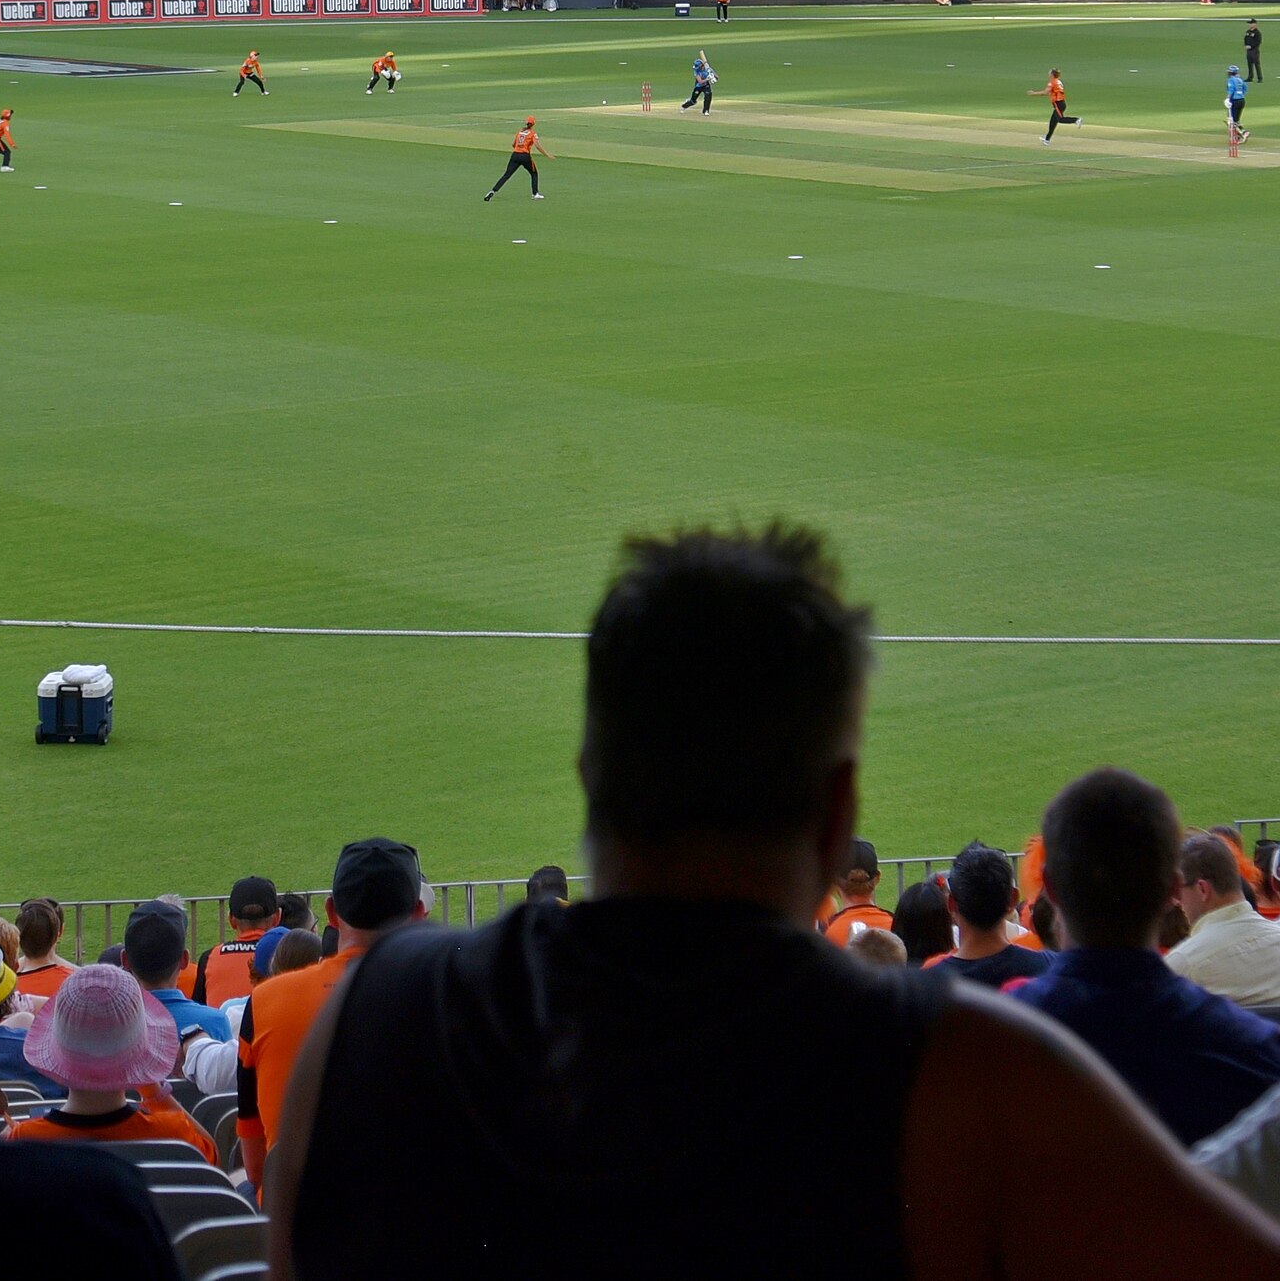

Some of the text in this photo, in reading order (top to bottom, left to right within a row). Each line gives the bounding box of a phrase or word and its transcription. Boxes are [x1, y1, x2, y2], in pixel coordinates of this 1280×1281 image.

[2, 2, 36, 20] weber
[55, 0, 88, 19] weber
[111, 0, 144, 17] weber
